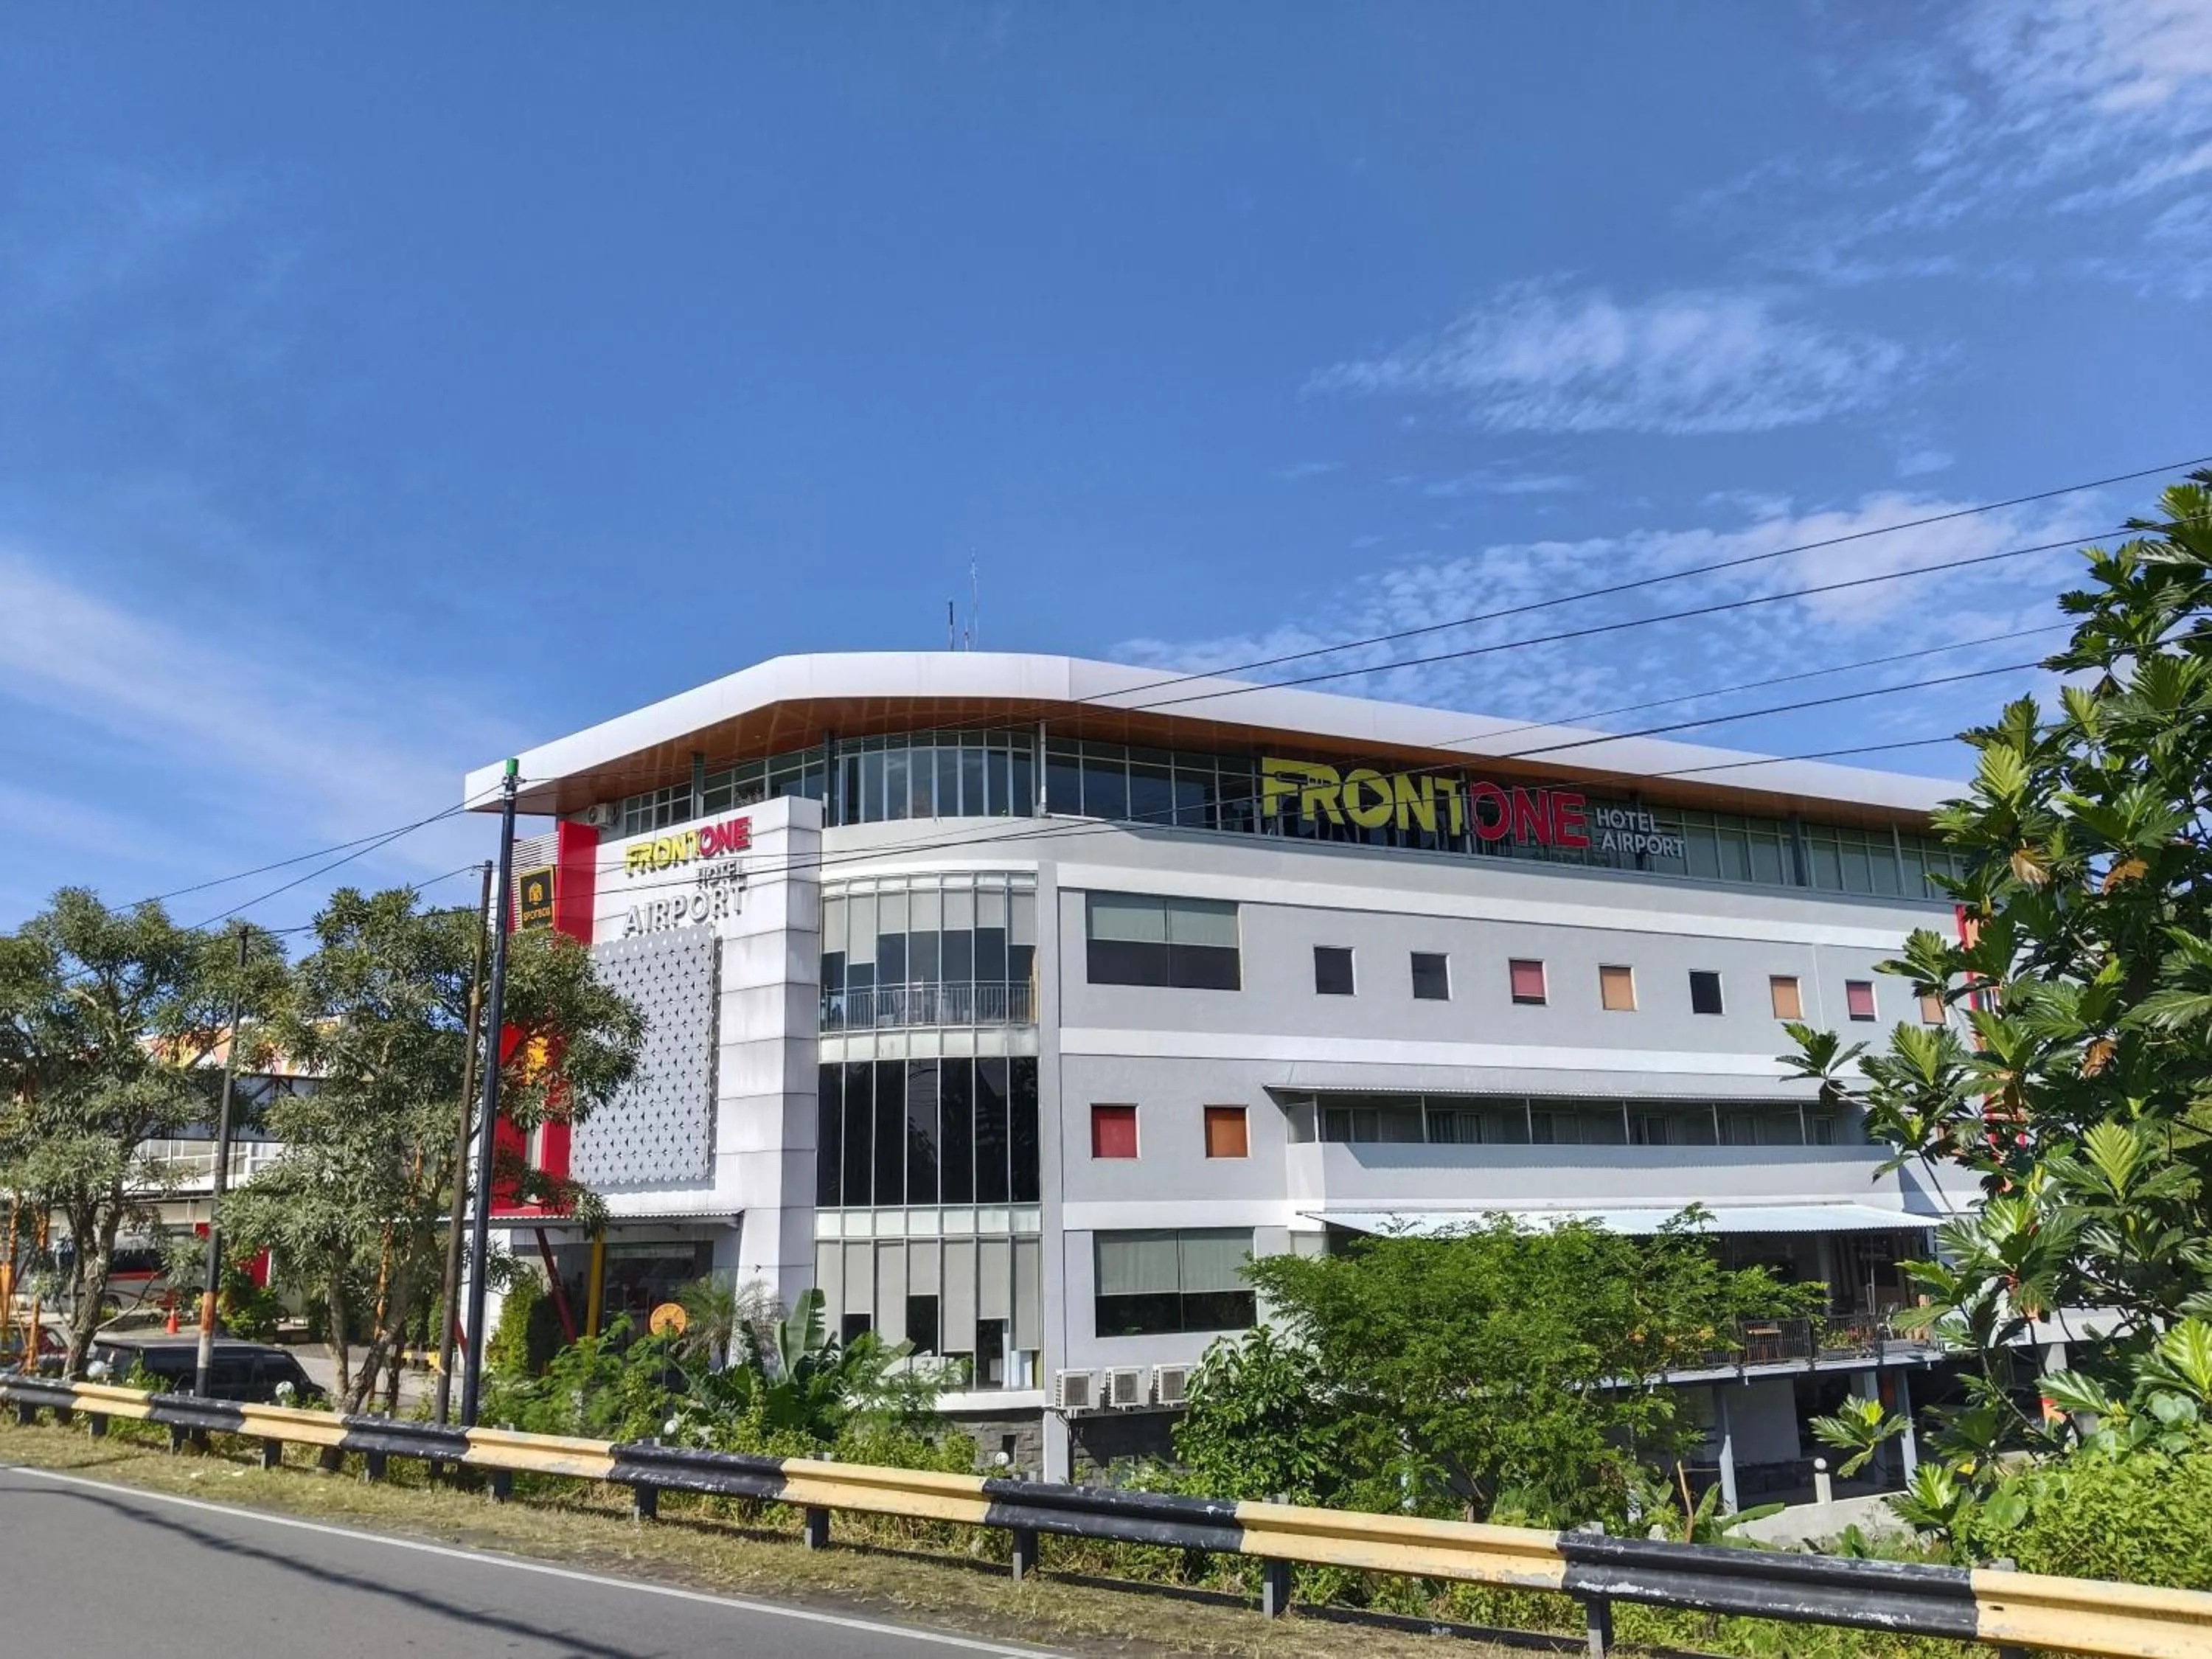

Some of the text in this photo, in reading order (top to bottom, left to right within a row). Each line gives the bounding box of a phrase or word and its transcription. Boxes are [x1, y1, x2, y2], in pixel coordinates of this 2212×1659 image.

[1596, 807, 1662, 832] HOTEL
[1601, 831, 1686, 858] AIRPORT
[697, 860, 745, 888] HOTEL
[622, 874, 748, 938] AIRPORT
